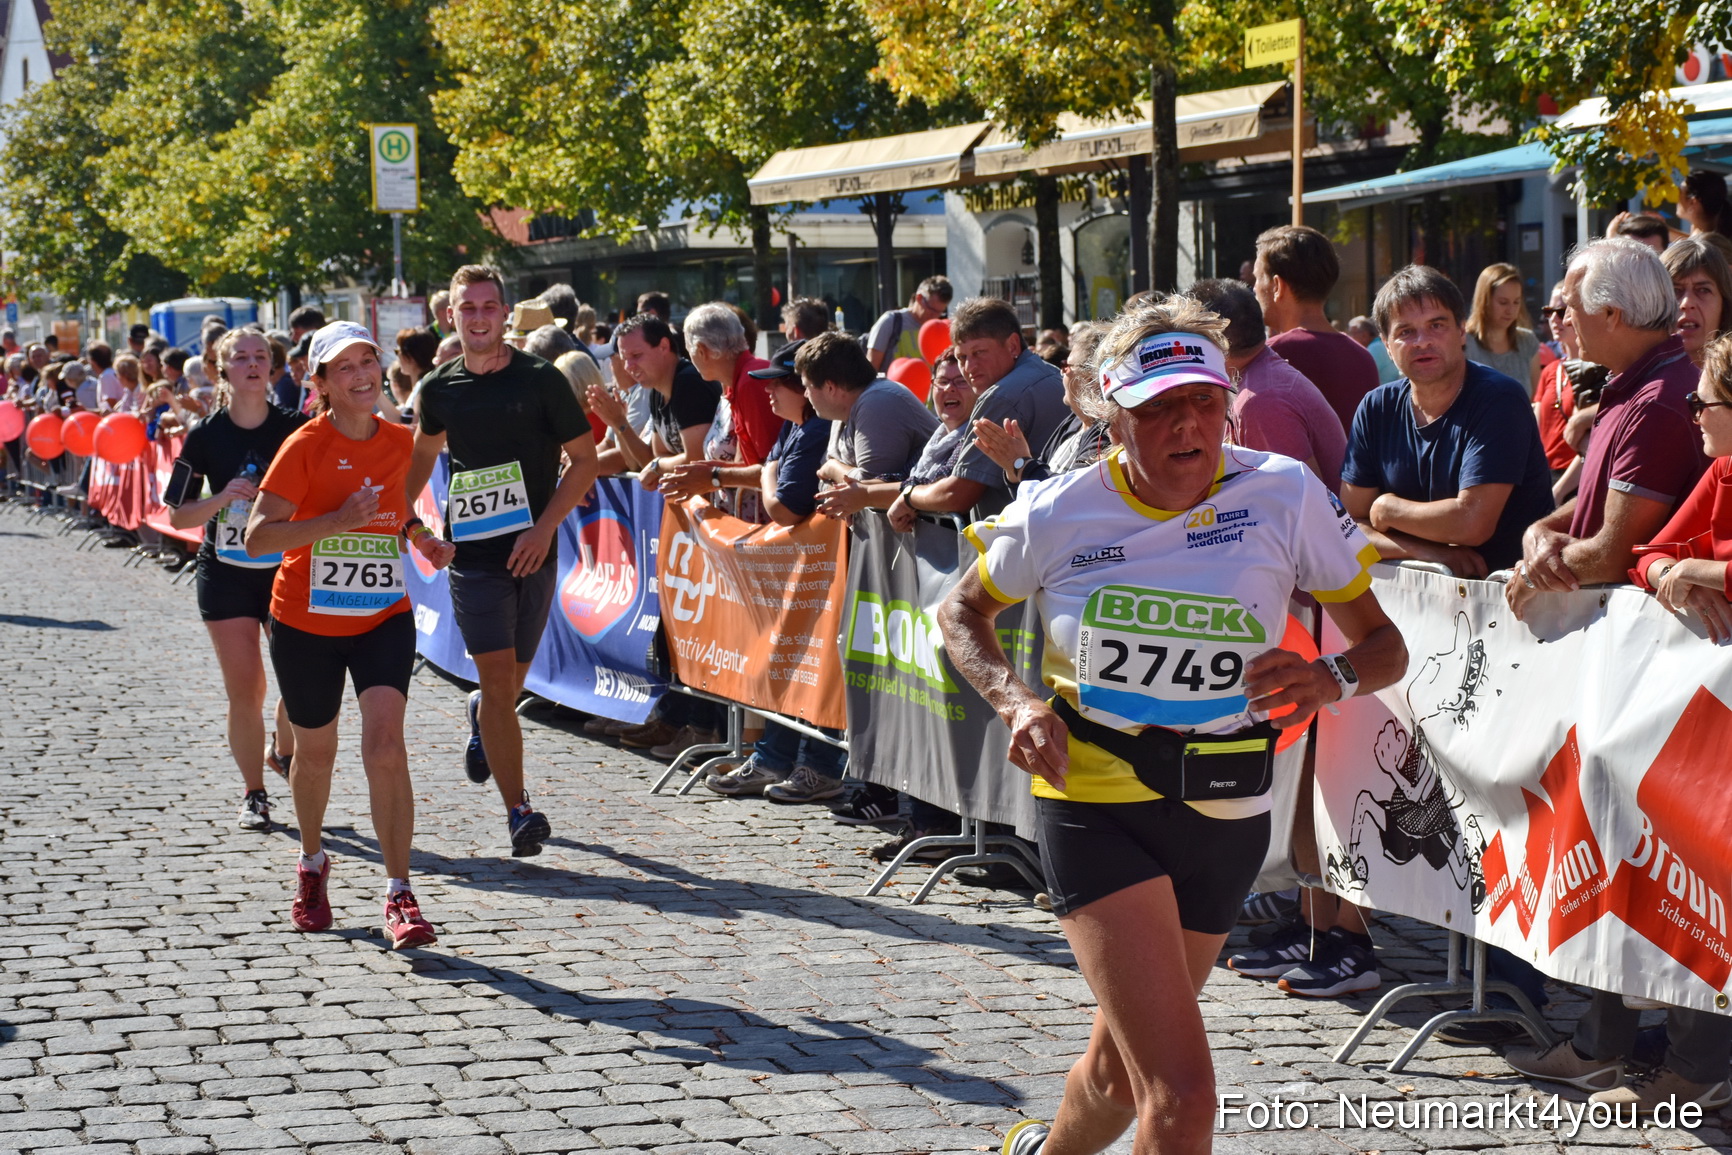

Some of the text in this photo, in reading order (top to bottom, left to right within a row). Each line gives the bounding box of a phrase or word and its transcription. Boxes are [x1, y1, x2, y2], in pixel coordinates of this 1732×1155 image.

[1256, 35, 1295, 54] Toiletten
[387, 138, 403, 156] H
[1139, 341, 1205, 366] IRONMAN
[1145, 341, 1171, 352] mainova
[453, 467, 516, 492] BOCK
[374, 511, 397, 520] ners
[455, 487, 518, 519] 2674
[1187, 508, 1247, 529] 20 JAHRE
[1187, 520, 1259, 543] Neumarkter
[319, 536, 394, 556] BOCK
[795, 542, 827, 554] Partner
[322, 562, 394, 588] 2763
[566, 542, 635, 614] Hervis
[324, 592, 392, 607] ANGELIKA
[1096, 589, 1252, 637] BOCK
[779, 633, 793, 646] Sie
[1098, 639, 1243, 692] 2749
[594, 665, 615, 698] GET
[843, 664, 898, 696] inspired
[1626, 807, 1727, 938] Braun
[1559, 876, 1611, 918] Sicher ist sicher
[1657, 898, 1691, 931] Sicher
[1690, 922, 1706, 942] ist
